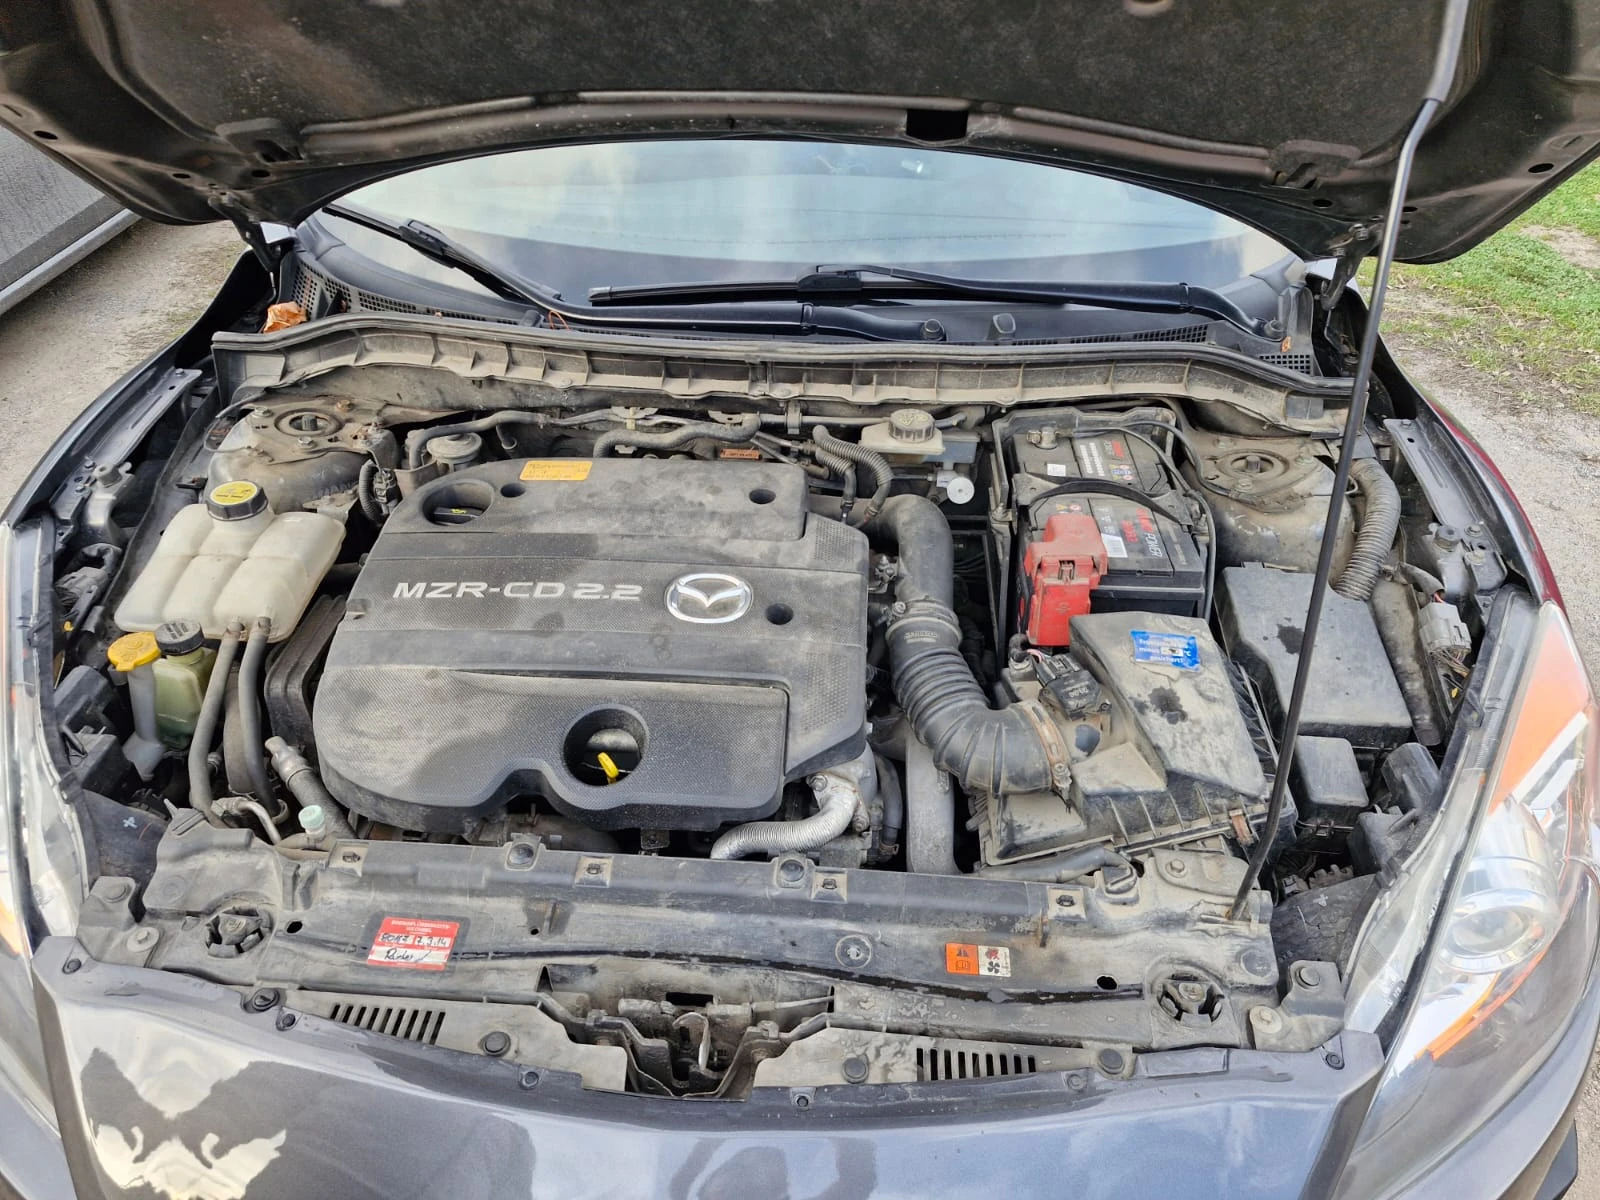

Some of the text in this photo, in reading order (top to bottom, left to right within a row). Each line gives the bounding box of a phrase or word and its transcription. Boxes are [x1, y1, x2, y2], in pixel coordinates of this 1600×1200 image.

[1145, 533, 1163, 558] POWER
[393, 581, 644, 600] MZR-CD 2.2
